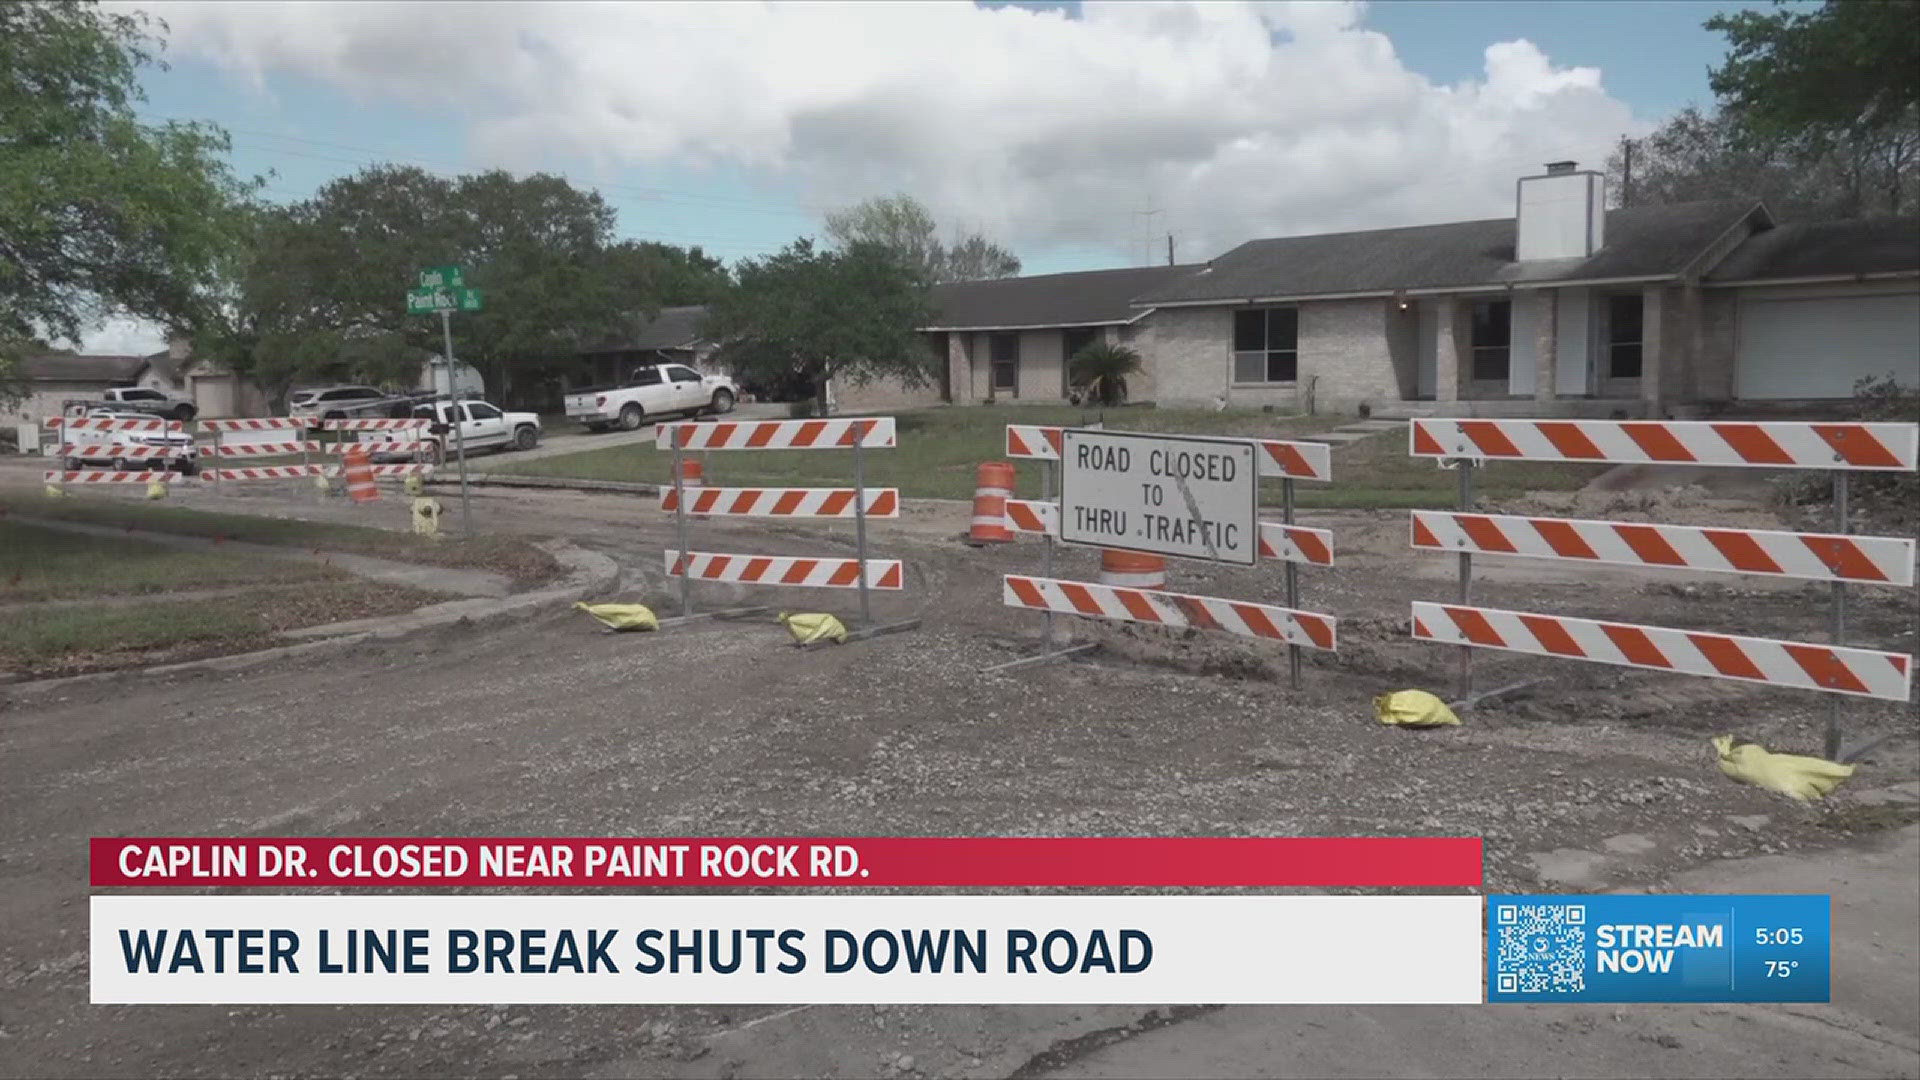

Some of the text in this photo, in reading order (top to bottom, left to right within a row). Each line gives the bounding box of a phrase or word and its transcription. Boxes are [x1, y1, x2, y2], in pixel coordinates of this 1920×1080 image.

[1078, 444, 1236, 482] ROAD CLOSED
[1142, 483, 1164, 507] TO
[1075, 505, 1238, 551] THRU TRAFFIC
